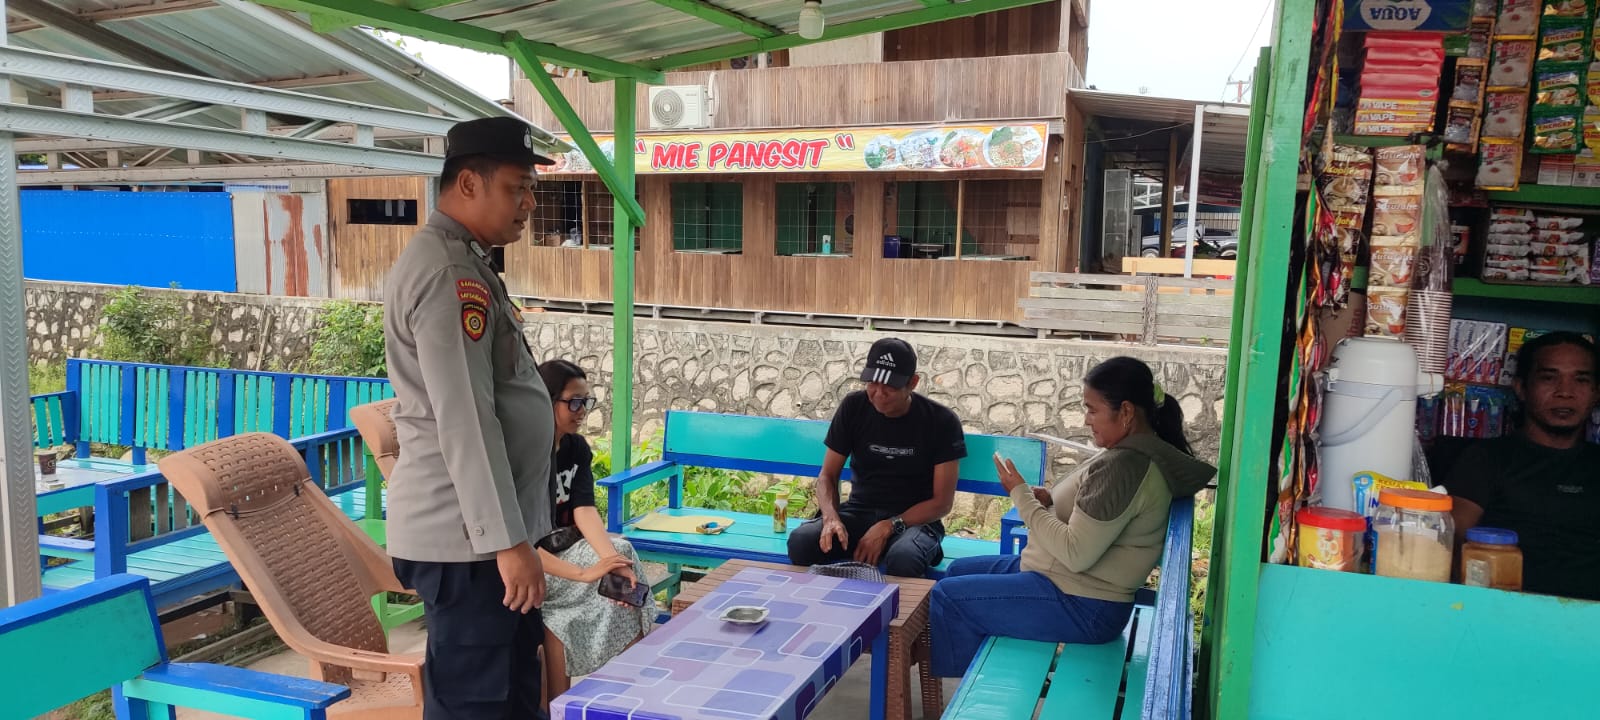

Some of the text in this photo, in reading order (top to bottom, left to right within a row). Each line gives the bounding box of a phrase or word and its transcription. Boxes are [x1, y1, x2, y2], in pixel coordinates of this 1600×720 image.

[1369, 6, 1422, 20] AQUA
[652, 143, 702, 169] MIE
[707, 139, 829, 169] PANGSIT
[876, 360, 896, 368] adidas
